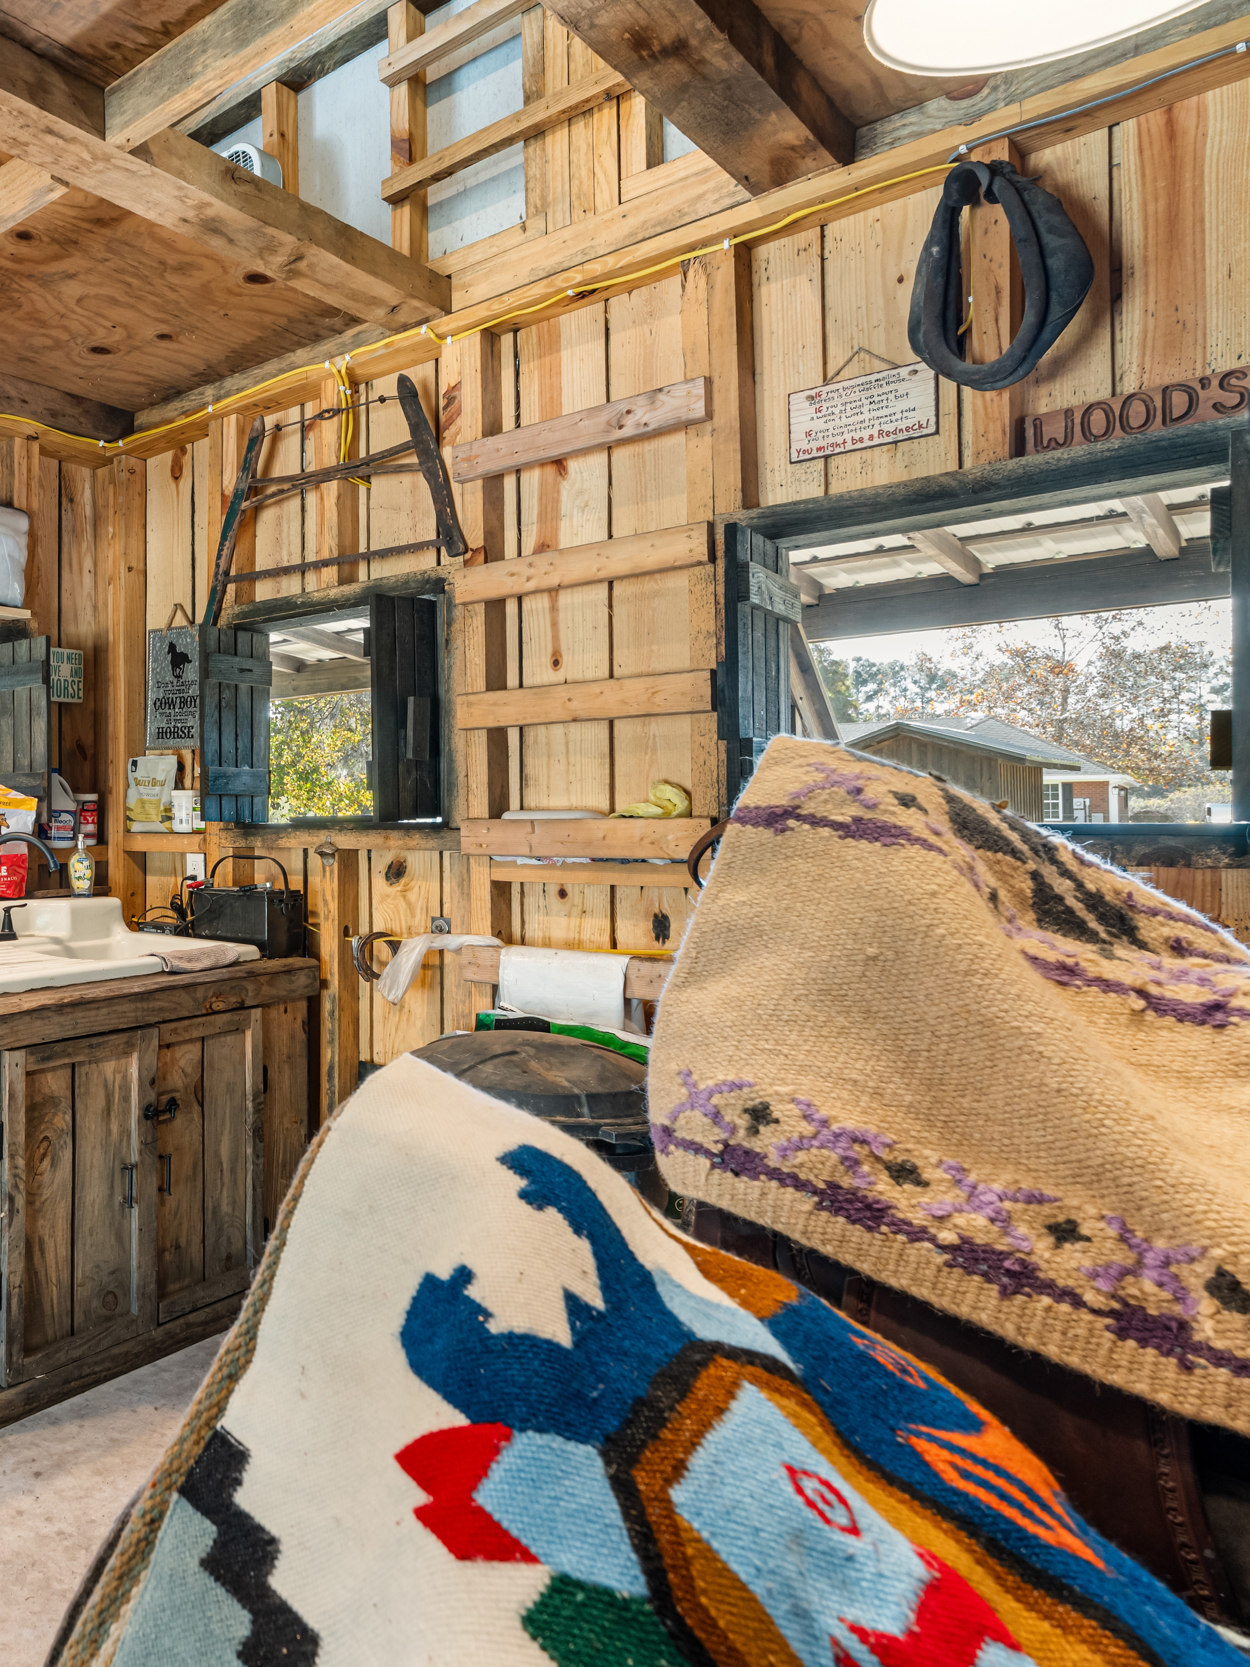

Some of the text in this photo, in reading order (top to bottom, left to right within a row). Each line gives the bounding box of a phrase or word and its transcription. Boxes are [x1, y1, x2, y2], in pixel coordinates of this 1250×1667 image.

[826, 388, 840, 397] your
[842, 380, 872, 391] business
[875, 372, 900, 383] mailing
[809, 396, 835, 406] address
[816, 410, 836, 419] week
[894, 392, 909, 400] but
[826, 404, 838, 412] you
[840, 397, 862, 408] spend
[877, 389, 898, 397] hours
[824, 415, 842, 424] don't
[845, 410, 864, 419] work
[1033, 369, 1250, 454] WOOD'S
[814, 428, 830, 437] your
[833, 418, 865, 430] financial
[868, 412, 897, 423] planner
[900, 407, 916, 416] told
[807, 437, 819, 445] you
[847, 424, 875, 434] lottery
[816, 438, 847, 452] might
[851, 436, 864, 445] be
[878, 418, 930, 439] Redneck!
[52, 651, 82, 666] YOU NEED
[70, 666, 82, 679] AND
[51, 678, 82, 700] HORSE
[156, 680, 174, 688] Don't
[154, 695, 199, 710] COWBOY
[173, 710, 197, 718] looking
[156, 726, 194, 740] HORSE
